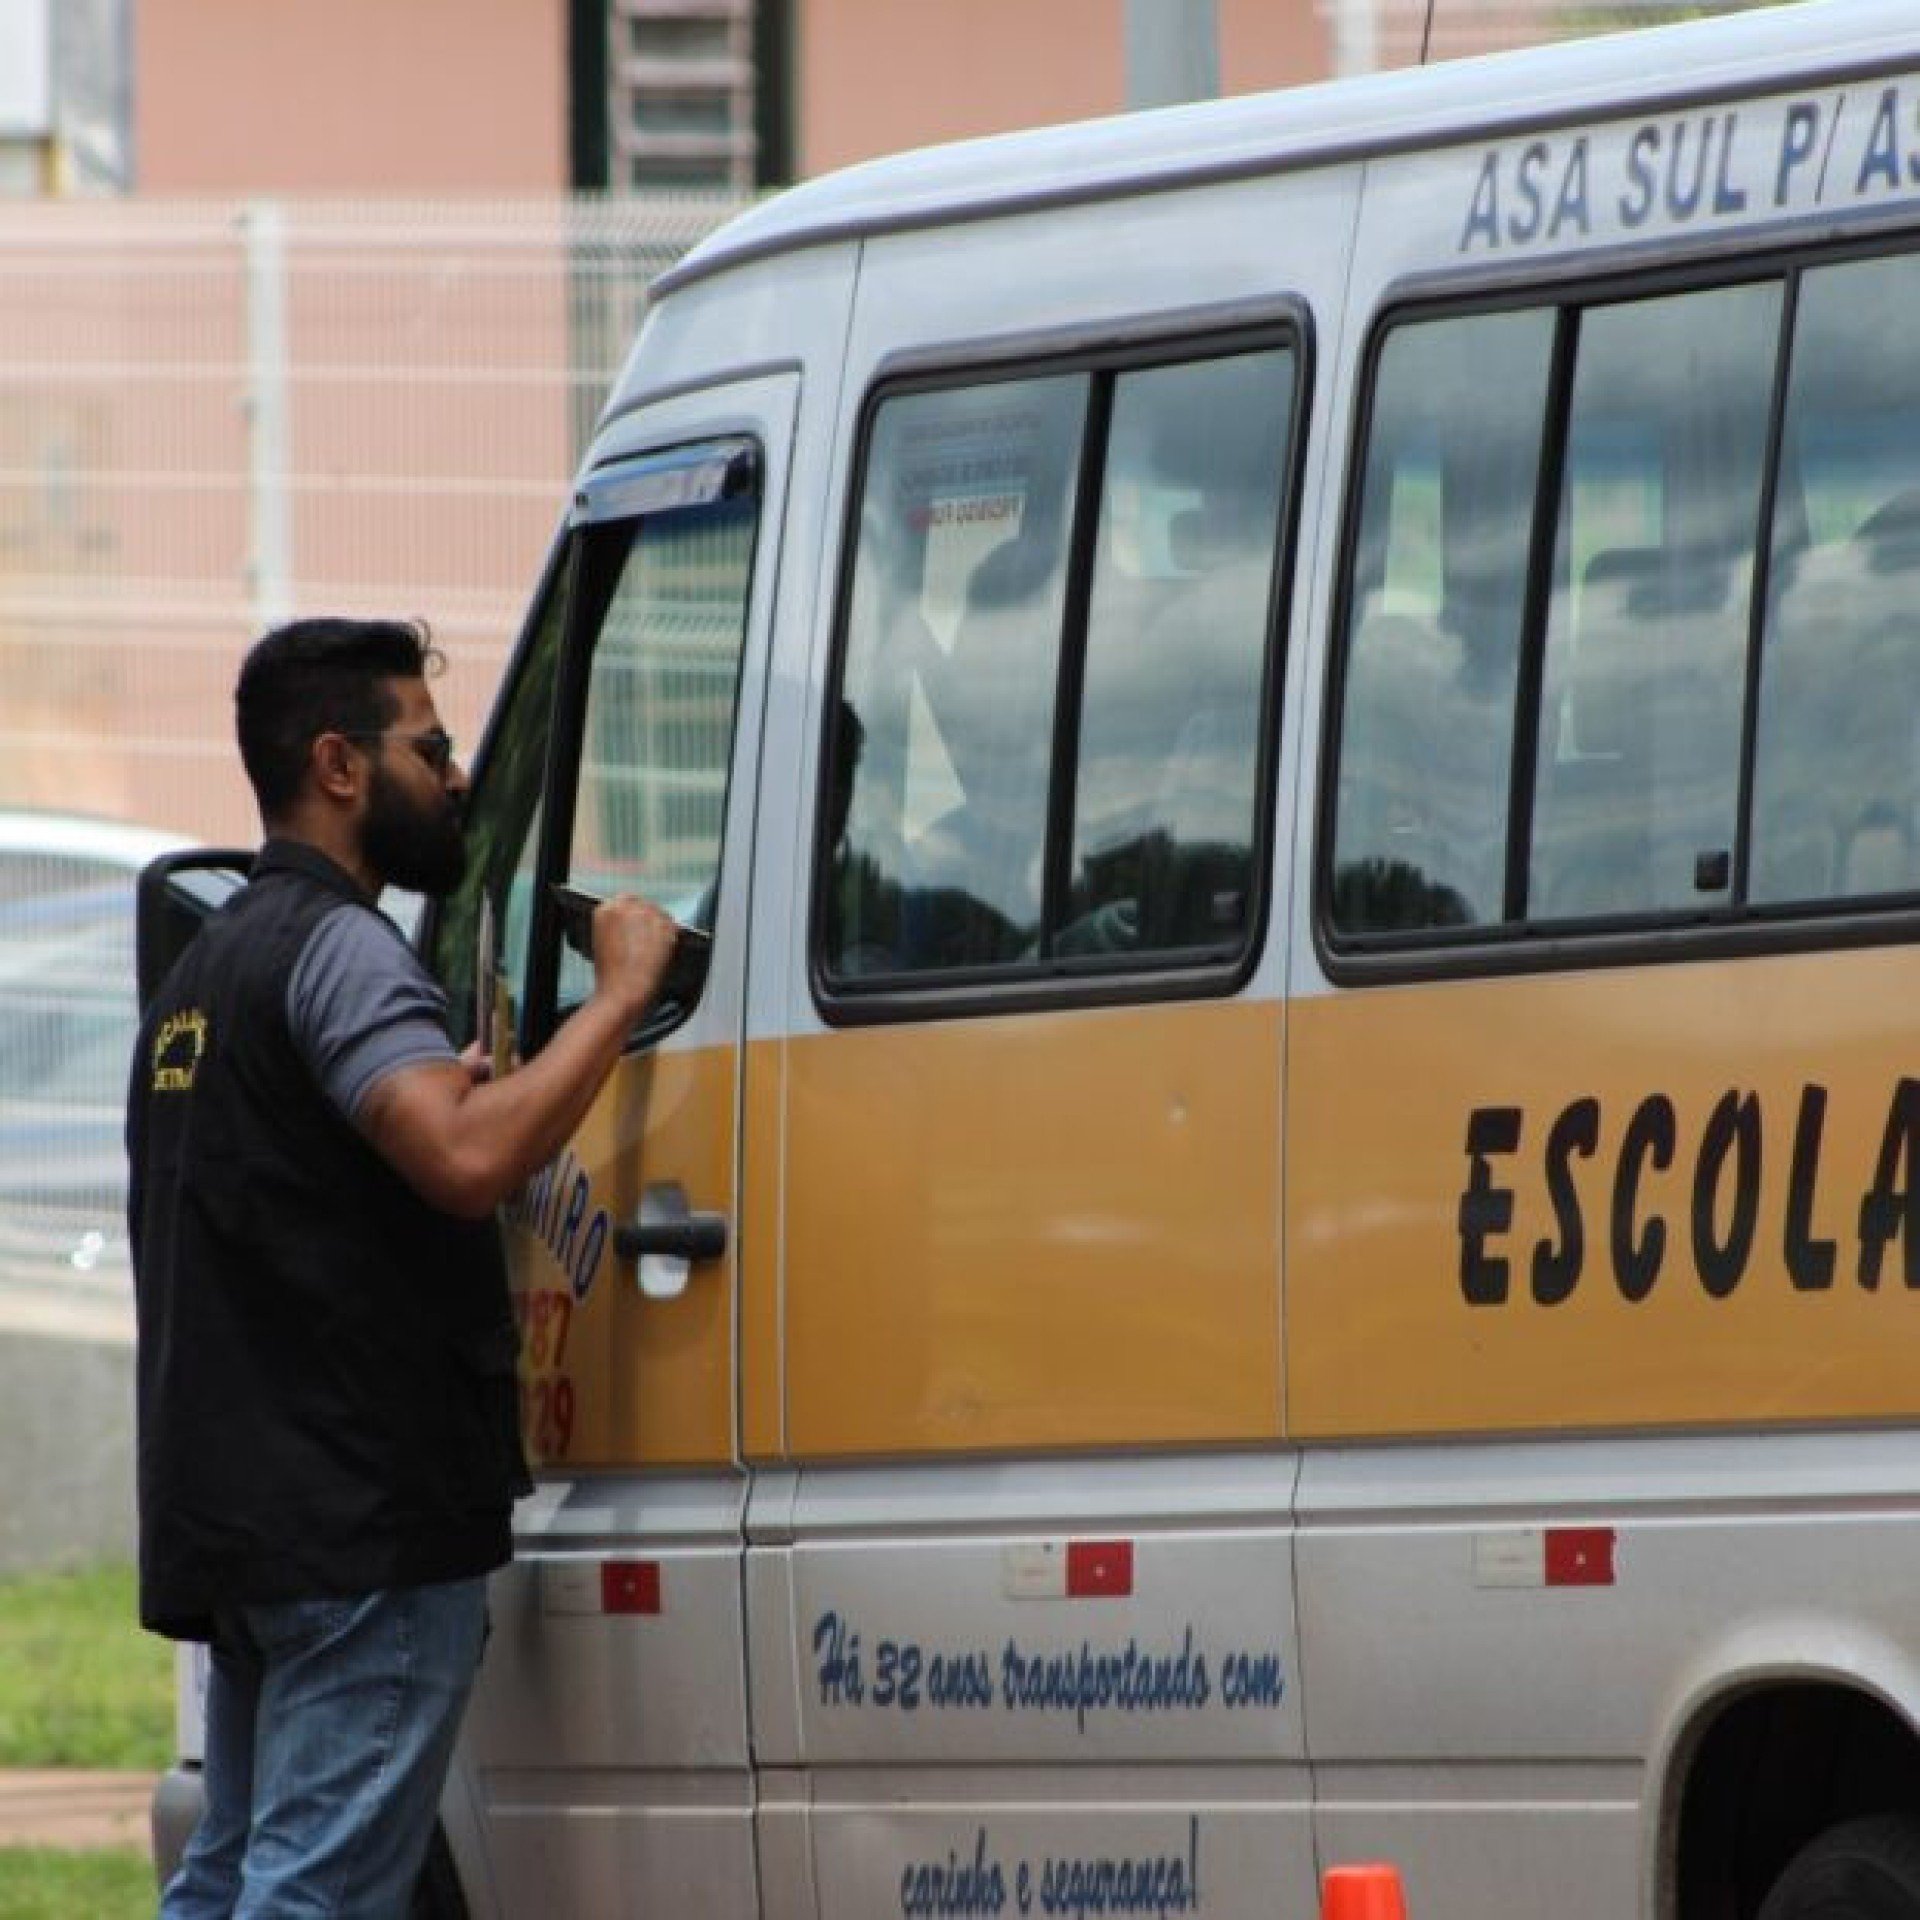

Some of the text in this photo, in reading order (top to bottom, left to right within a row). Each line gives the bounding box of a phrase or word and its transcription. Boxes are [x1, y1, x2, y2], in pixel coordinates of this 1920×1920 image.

[1459, 136, 1590, 252] ASA
[1618, 112, 1748, 229] SUL
[1773, 93, 1847, 208] P/
[1458, 1077, 1920, 1307] ESCOLA
[813, 1609, 1286, 1734] Há 32 anos transportando com
[900, 1812, 1198, 1920] carinho e segurança!
